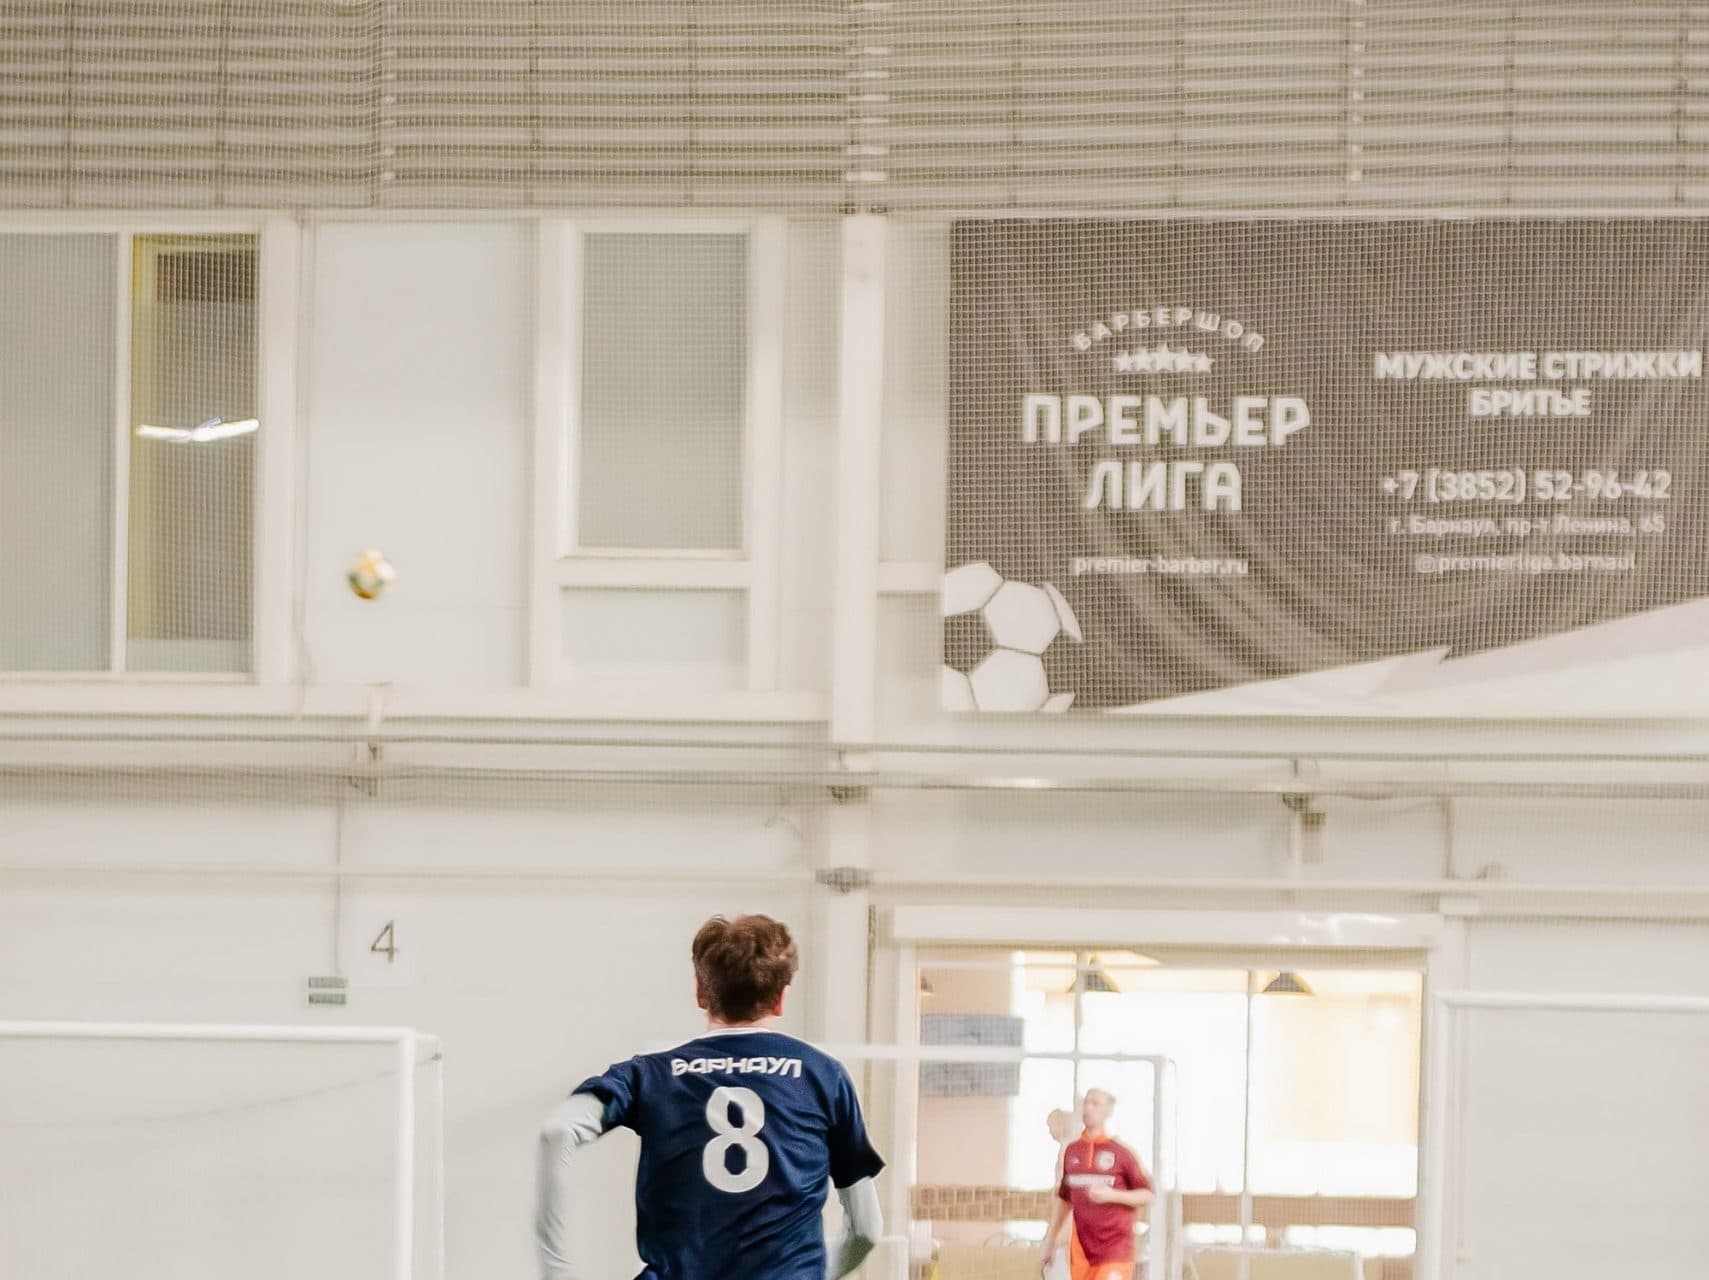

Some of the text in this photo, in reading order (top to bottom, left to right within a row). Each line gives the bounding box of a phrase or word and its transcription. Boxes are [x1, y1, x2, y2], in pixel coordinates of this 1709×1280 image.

[1073, 307, 1265, 352] БАРБЕРШОП
[1376, 351, 1702, 379] МУЖСКИЕ СТРИЖКИ
[1023, 394, 1311, 445] ПРЕМЬЕР
[1472, 388, 1592, 416] БРИТЬЕ
[1086, 461, 1242, 511] ЛИГА
[1382, 468, 1672, 504] +7 (3852) 52-96-42
[1073, 555, 1249, 576] premier-barber.ru
[371, 919, 399, 963] 4
[671, 1057, 803, 1079] БАРНАУЛ
[702, 1086, 770, 1193] 8
